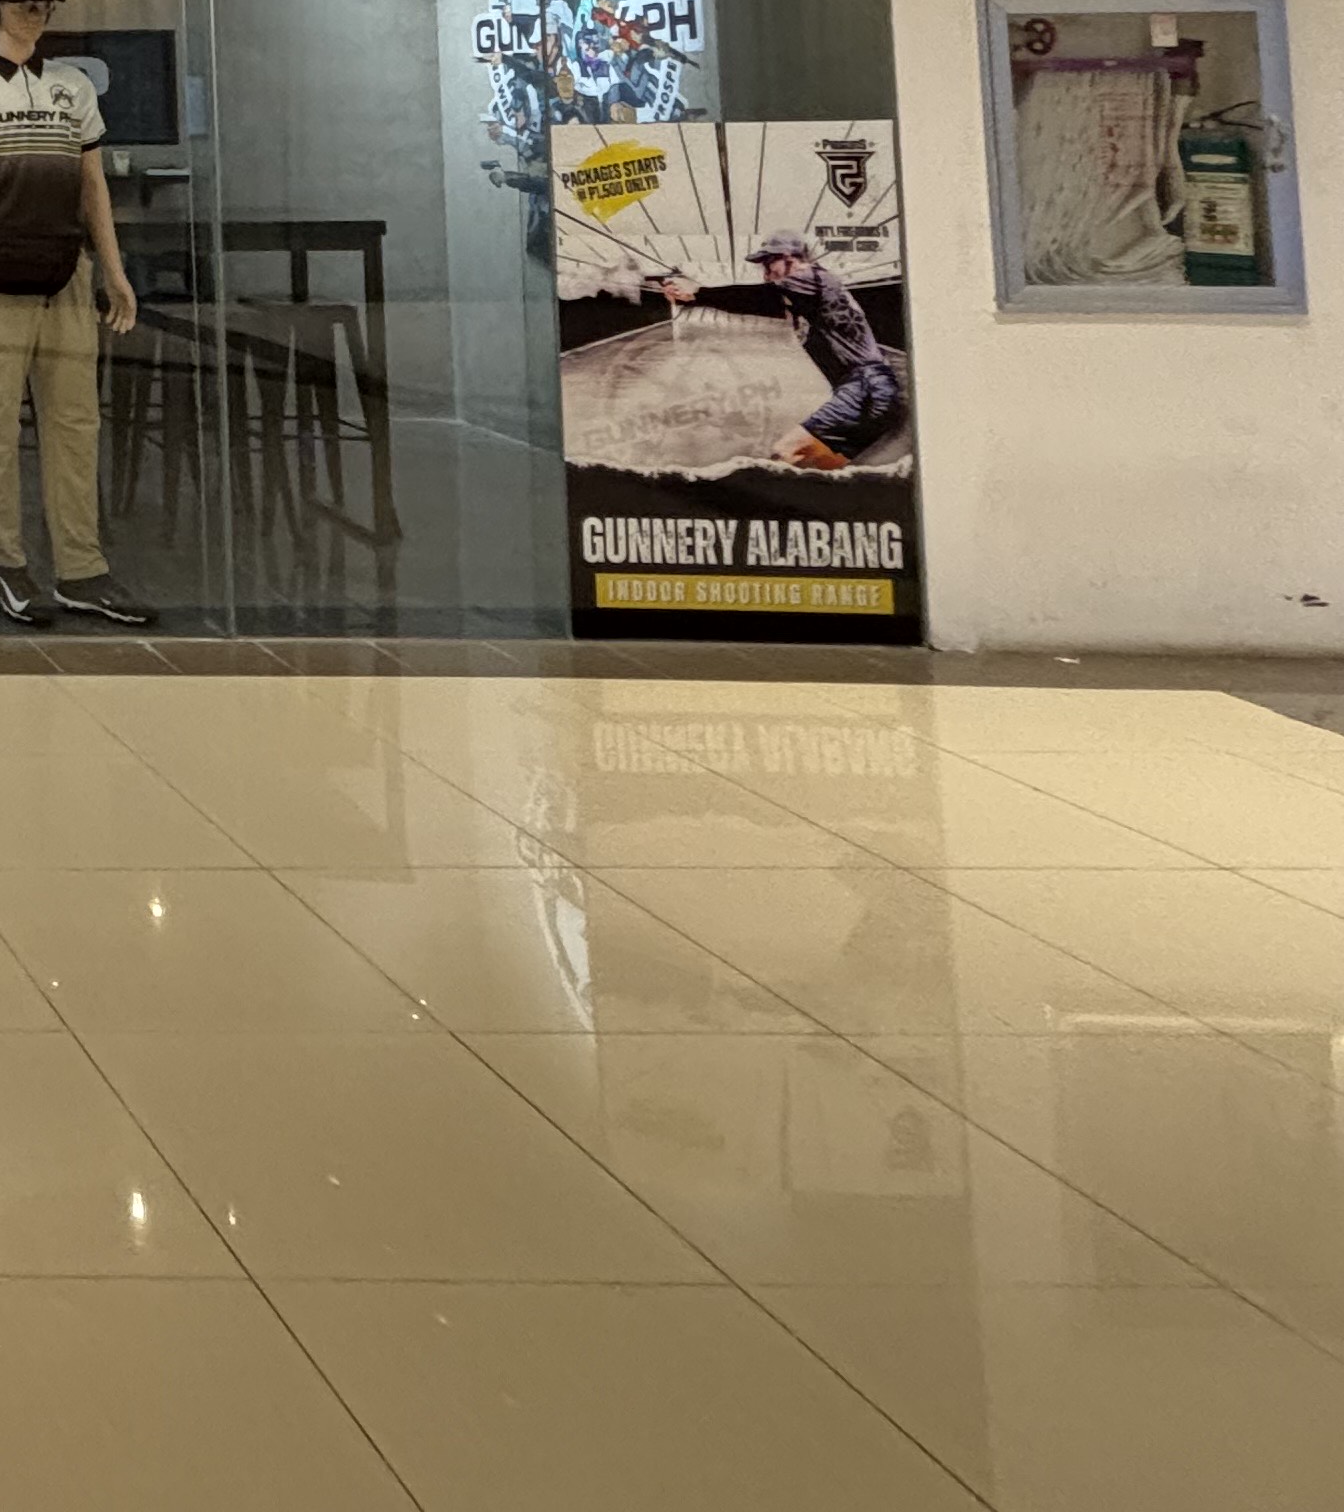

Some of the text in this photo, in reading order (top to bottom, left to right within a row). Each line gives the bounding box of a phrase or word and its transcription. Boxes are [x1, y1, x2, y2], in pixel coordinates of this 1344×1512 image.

[561, 155, 667, 189] PACKAGES STARTS
[582, 516, 904, 569] GUNNERY ALABANG
[607, 579, 881, 607] INDOOR SHOOTING RANGE
